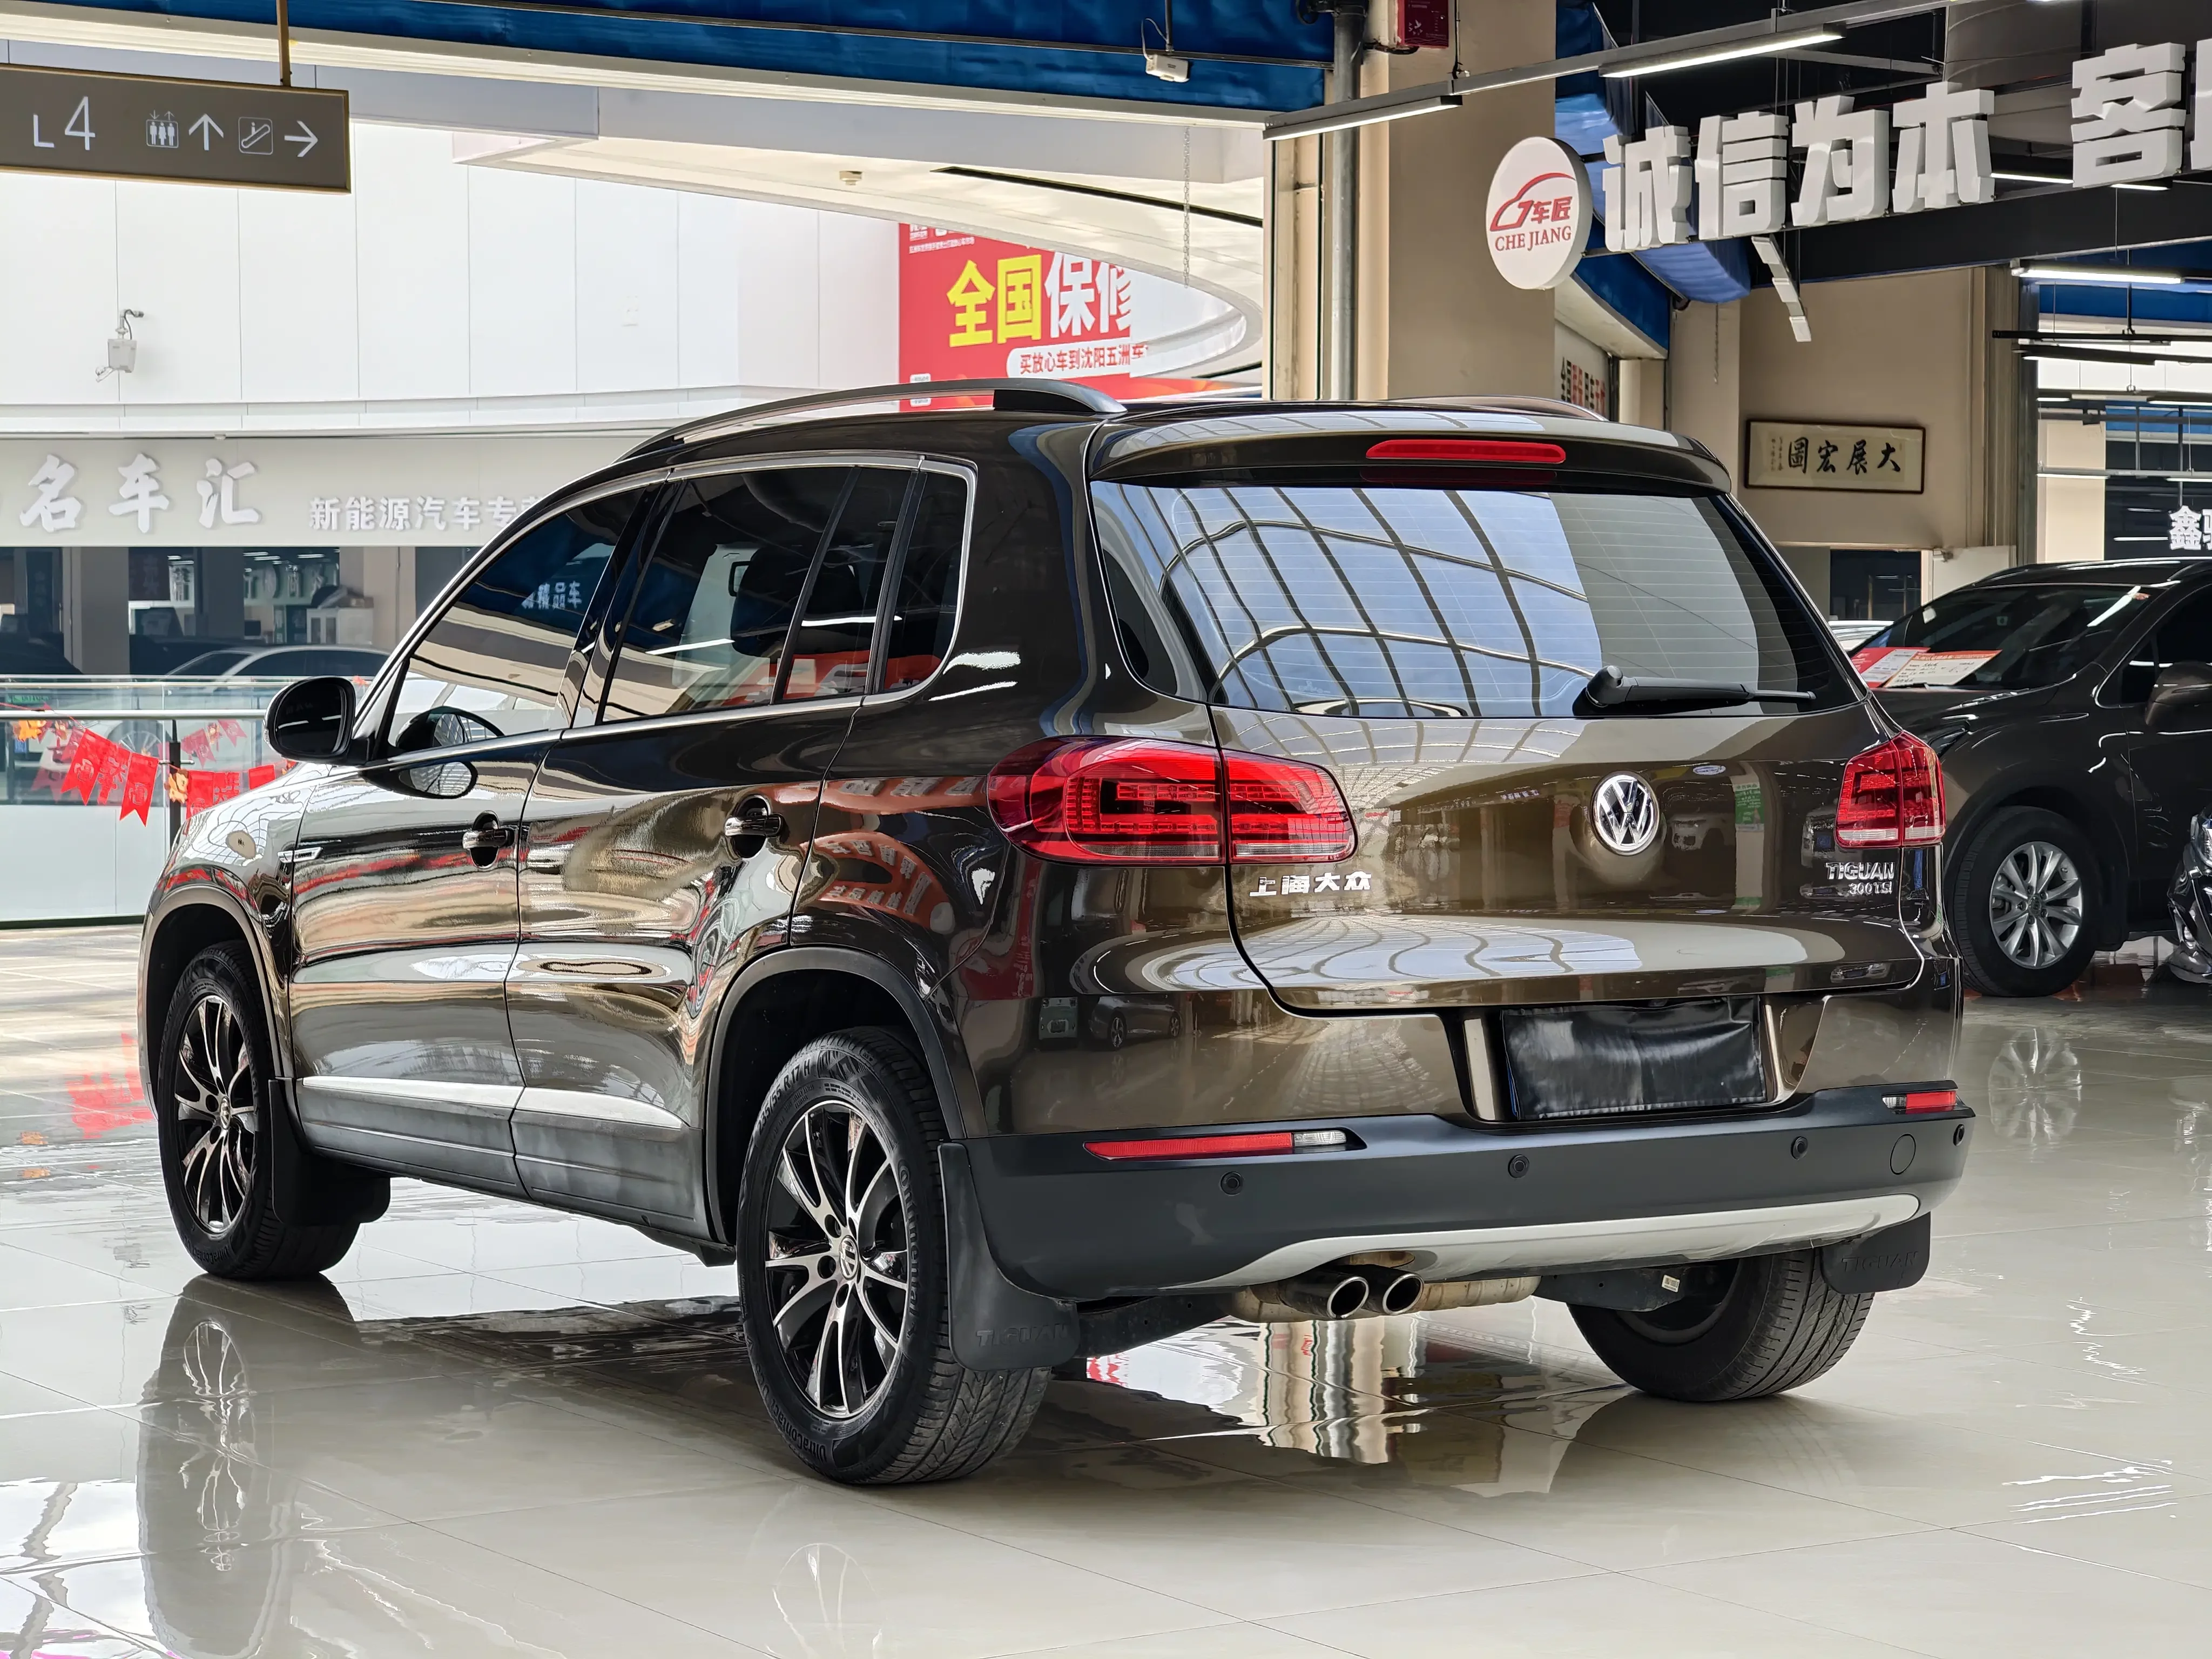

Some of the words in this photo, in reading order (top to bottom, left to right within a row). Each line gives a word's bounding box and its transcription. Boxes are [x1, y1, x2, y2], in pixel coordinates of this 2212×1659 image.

[1603, 81, 1995, 253] 诚信为本
[2071, 42, 2212, 188] 客
[1530, 197, 1573, 224] 车匠
[1495, 233, 1526, 252] CHE
[1527, 226, 1572, 251] JIANG
[946, 252, 1132, 347] 全国保修
[2169, 505, 2212, 550] 鑫
[1249, 869, 1373, 897] 上海大众
[1825, 862, 1895, 880] TIGUAN
[1842, 1251, 1919, 1272] TIGUAN
[975, 1323, 1068, 1348] TIGUAN
